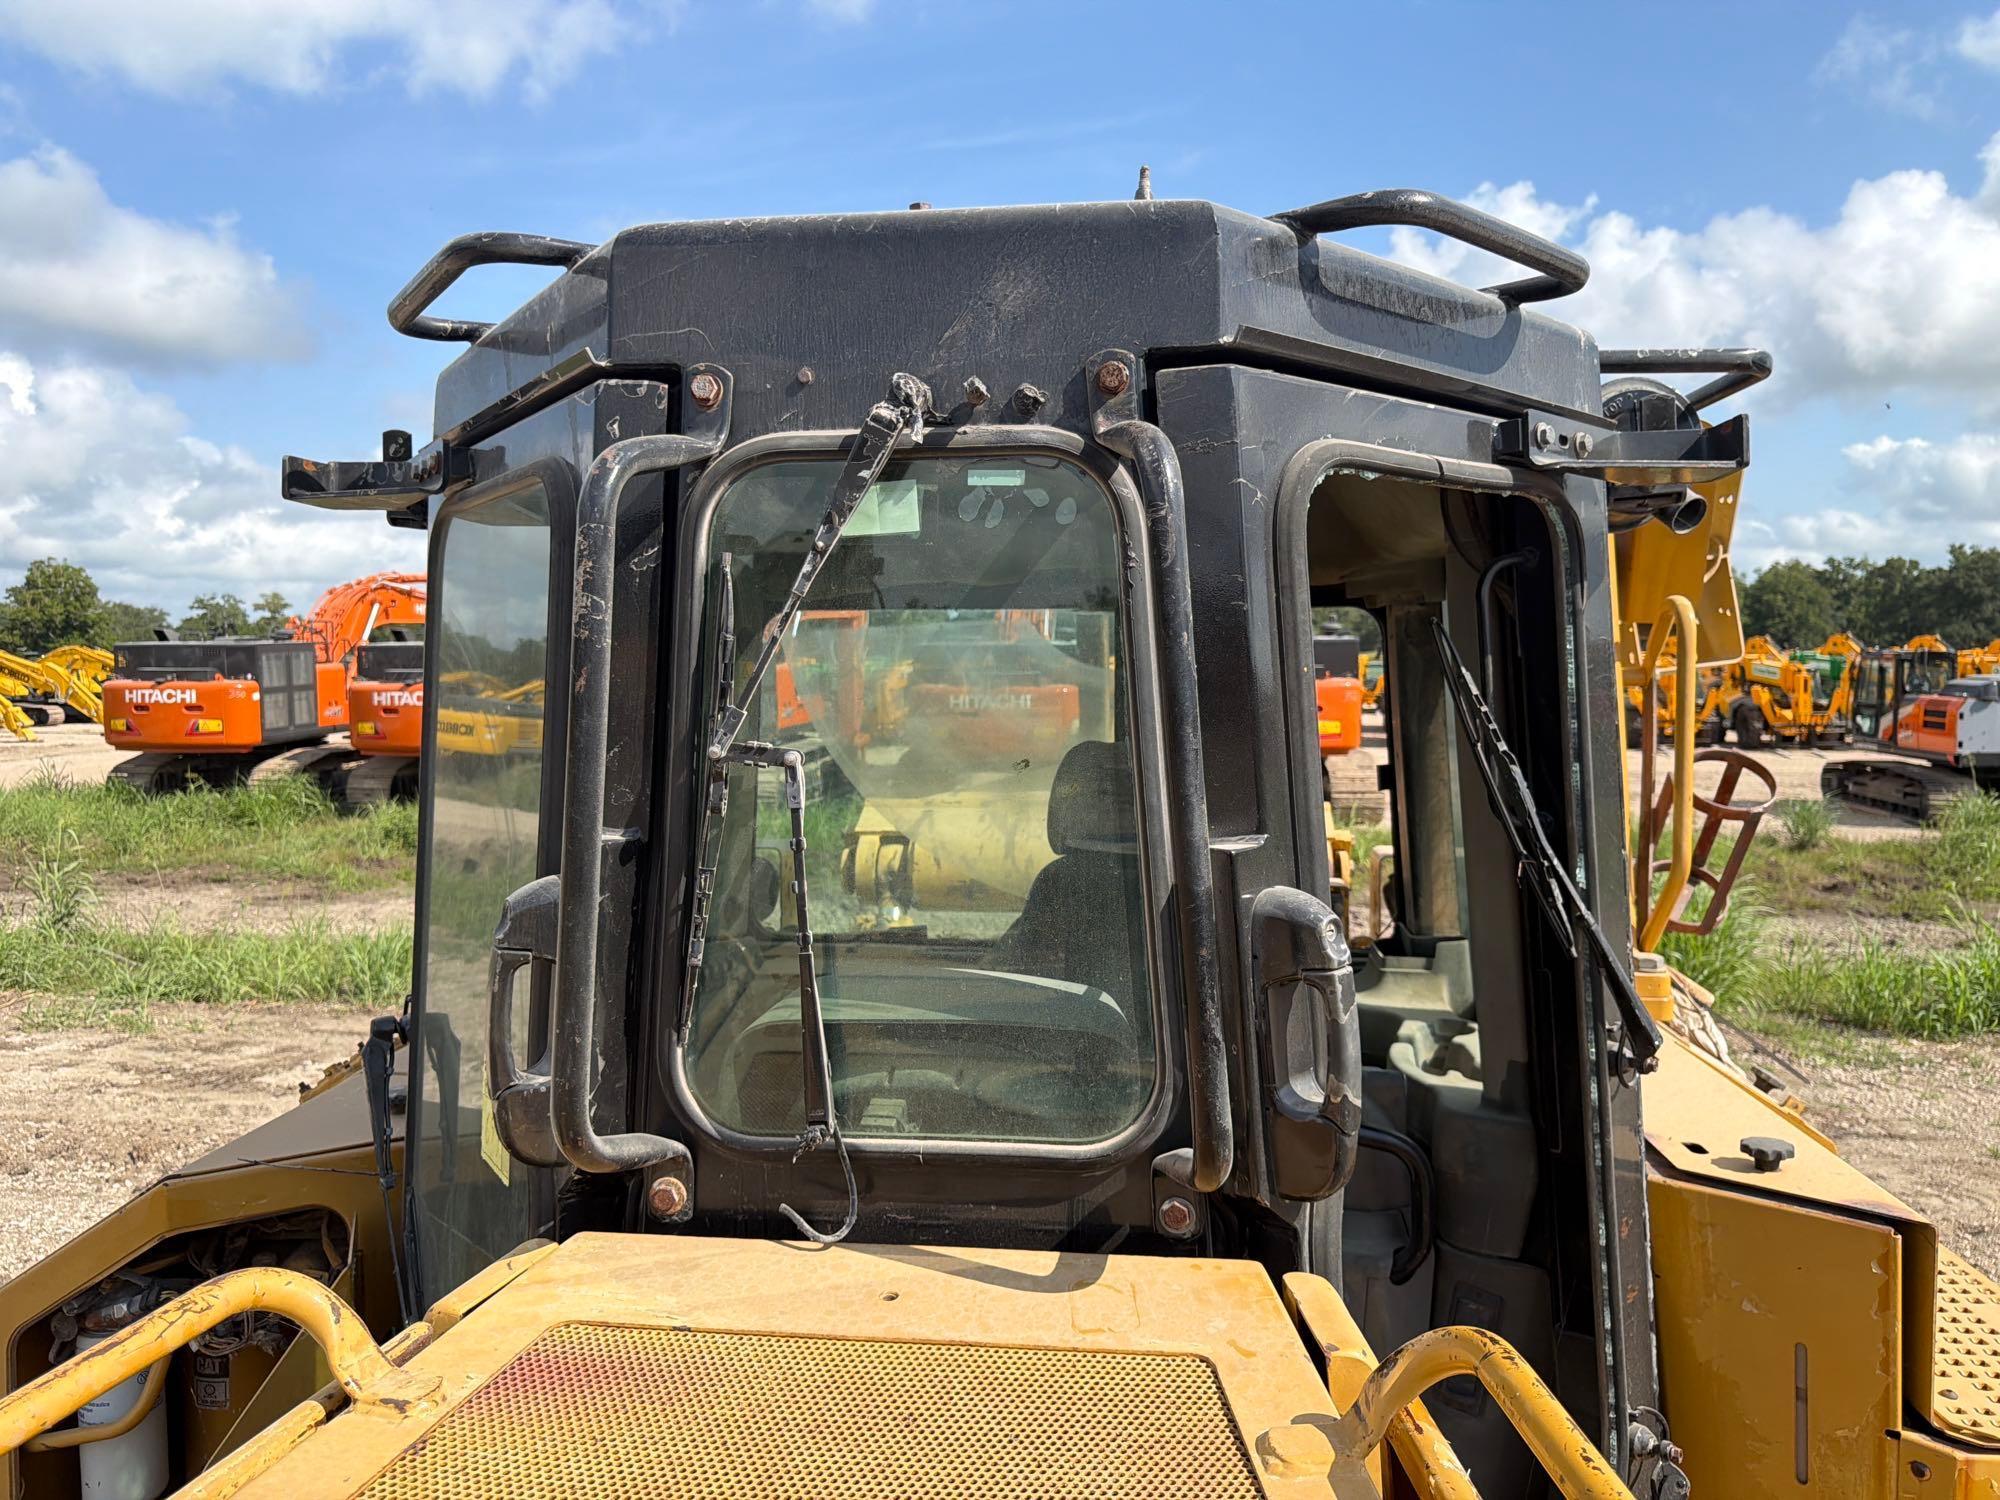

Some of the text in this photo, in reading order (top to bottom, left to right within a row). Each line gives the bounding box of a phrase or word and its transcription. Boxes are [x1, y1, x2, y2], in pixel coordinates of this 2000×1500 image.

[125, 688, 197, 704] HITACHI
[949, 694, 1031, 709] HITACHI
[197, 1357, 223, 1375] CAT
